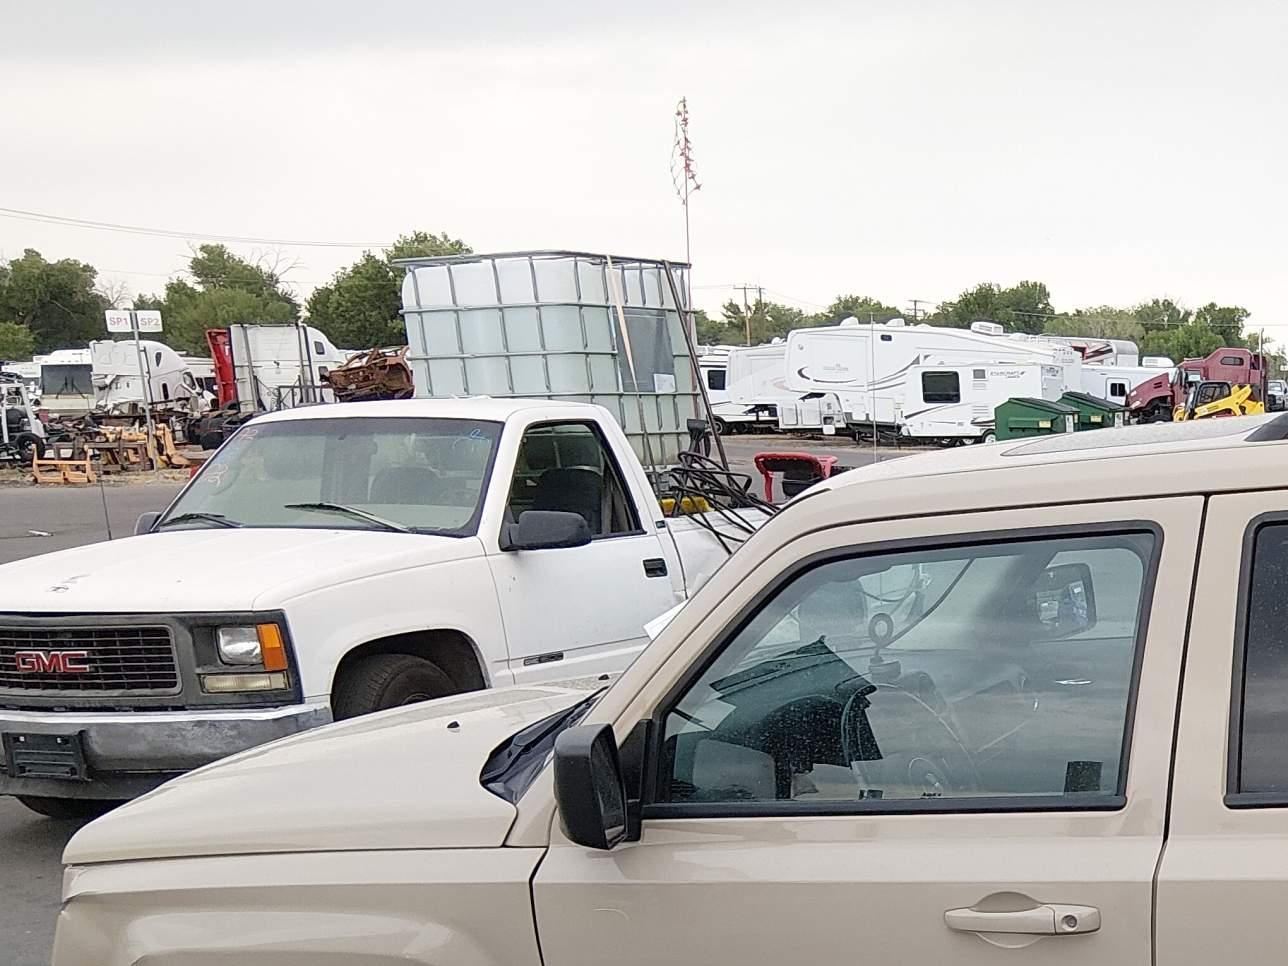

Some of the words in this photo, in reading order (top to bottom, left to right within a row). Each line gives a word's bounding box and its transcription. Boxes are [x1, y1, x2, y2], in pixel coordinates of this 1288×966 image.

[109, 317, 129, 326] SP1
[140, 317, 161, 326] SP2
[15, 651, 90, 673] GMC
